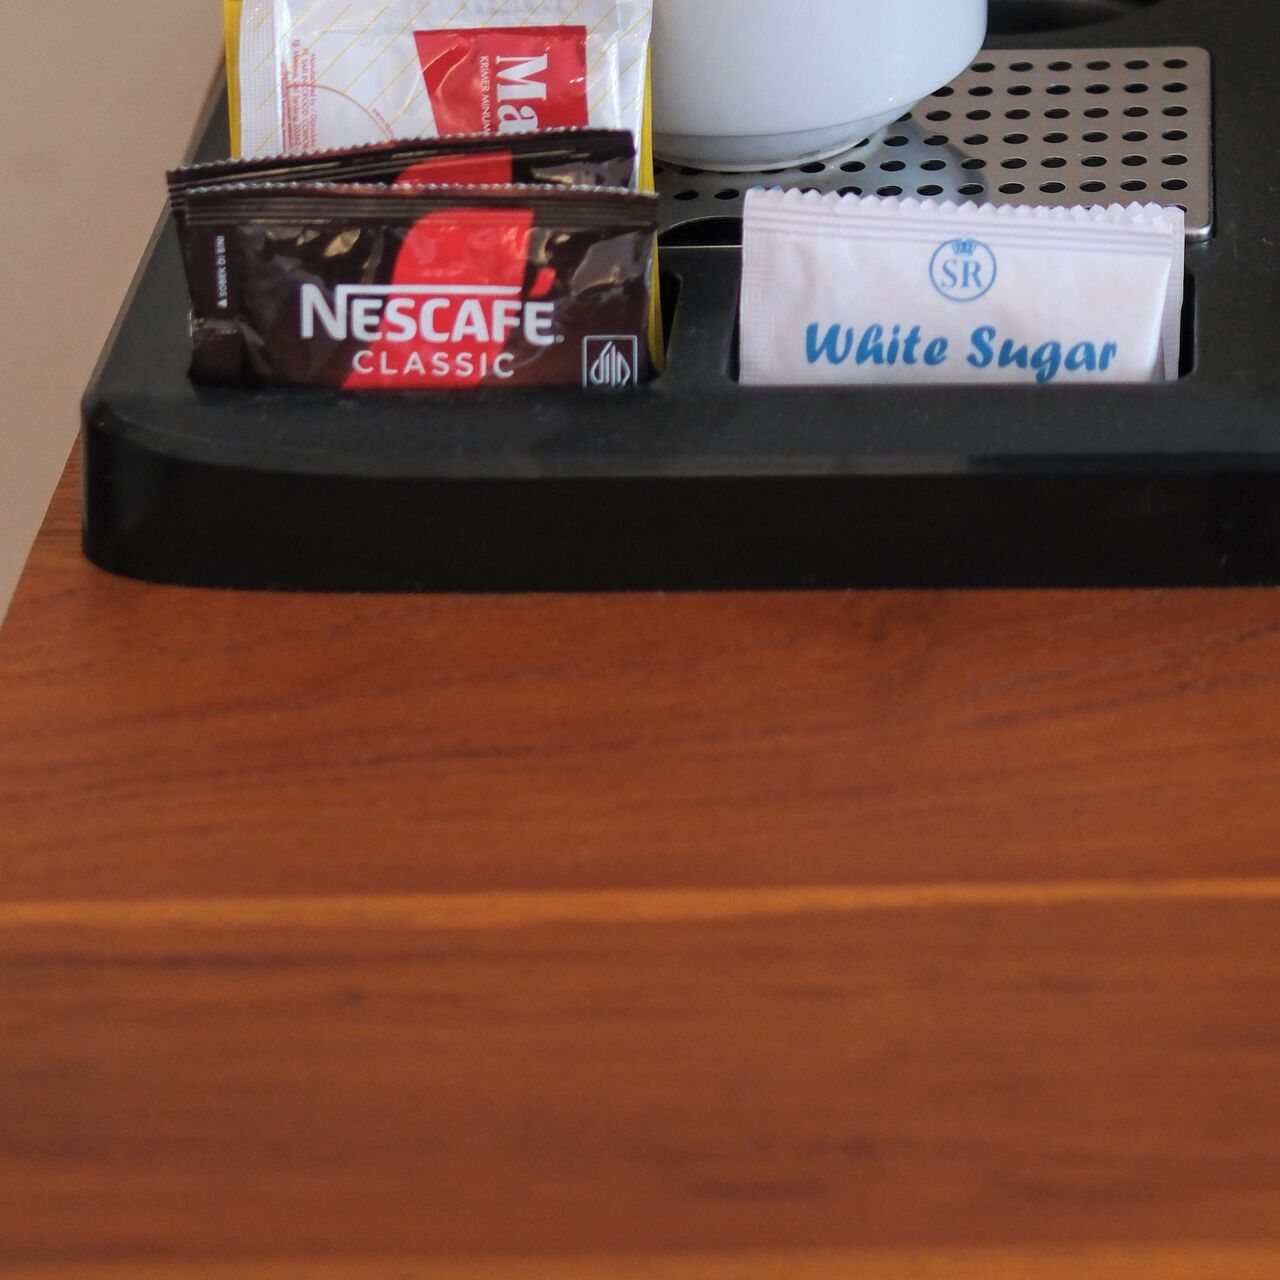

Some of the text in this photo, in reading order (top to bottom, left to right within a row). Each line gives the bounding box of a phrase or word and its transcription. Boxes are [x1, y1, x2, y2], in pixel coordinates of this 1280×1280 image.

[480, 55, 491, 134] KRIMER MINUM
[216, 235, 228, 297] SOBEK DI SINI
[941, 257, 983, 289] SR
[351, 350, 515, 379] CLASSIC
[804, 322, 1118, 383] White Sugar
